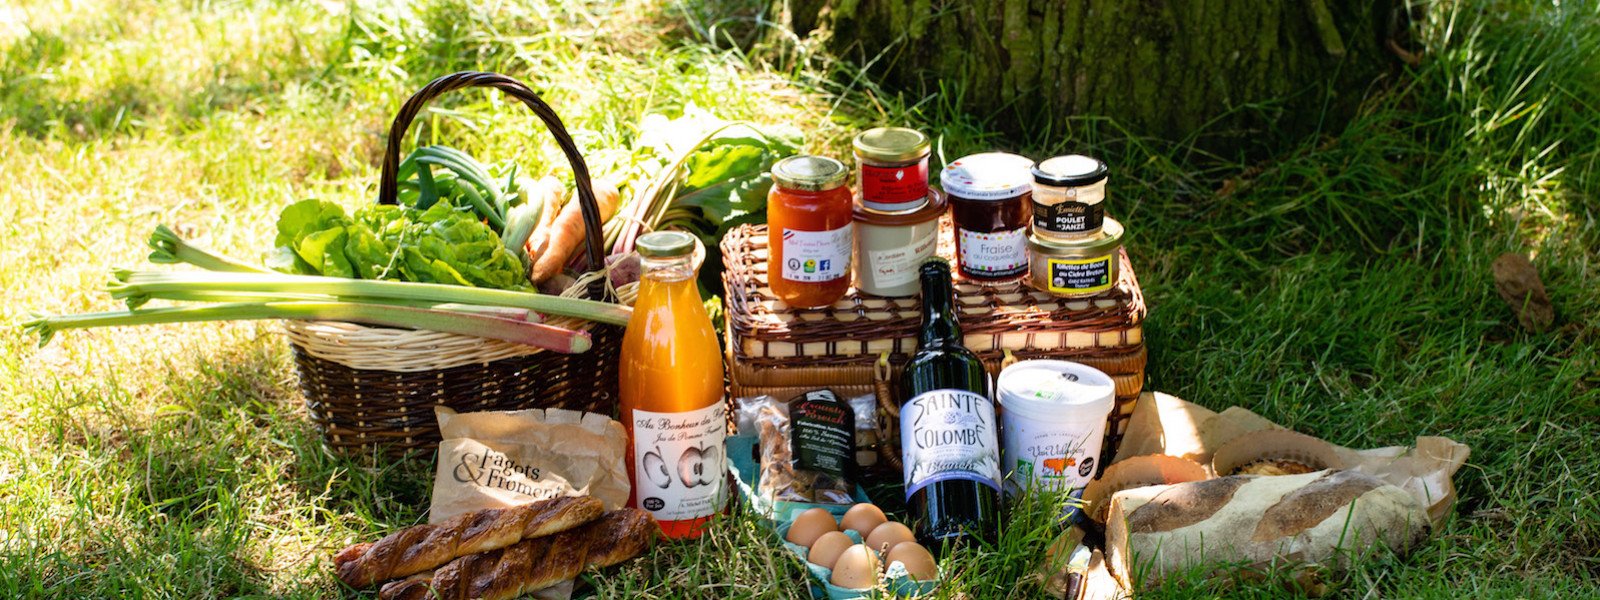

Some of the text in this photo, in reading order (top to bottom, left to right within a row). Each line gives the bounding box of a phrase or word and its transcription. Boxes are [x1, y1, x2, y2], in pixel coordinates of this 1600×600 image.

[1056, 216, 1086, 224] POULET
[1061, 222, 1086, 231] JANZÉ
[980, 243, 1013, 255] Fraise
[1086, 269, 1105, 277] Breton
[913, 393, 985, 426] SAINTE
[637, 418, 654, 429] Au
[656, 418, 699, 430] Bonheur
[653, 433, 666, 444] Jus
[914, 424, 986, 449] COLOMBE
[479, 448, 540, 480] Fagots
[453, 452, 563, 499] & Froment
